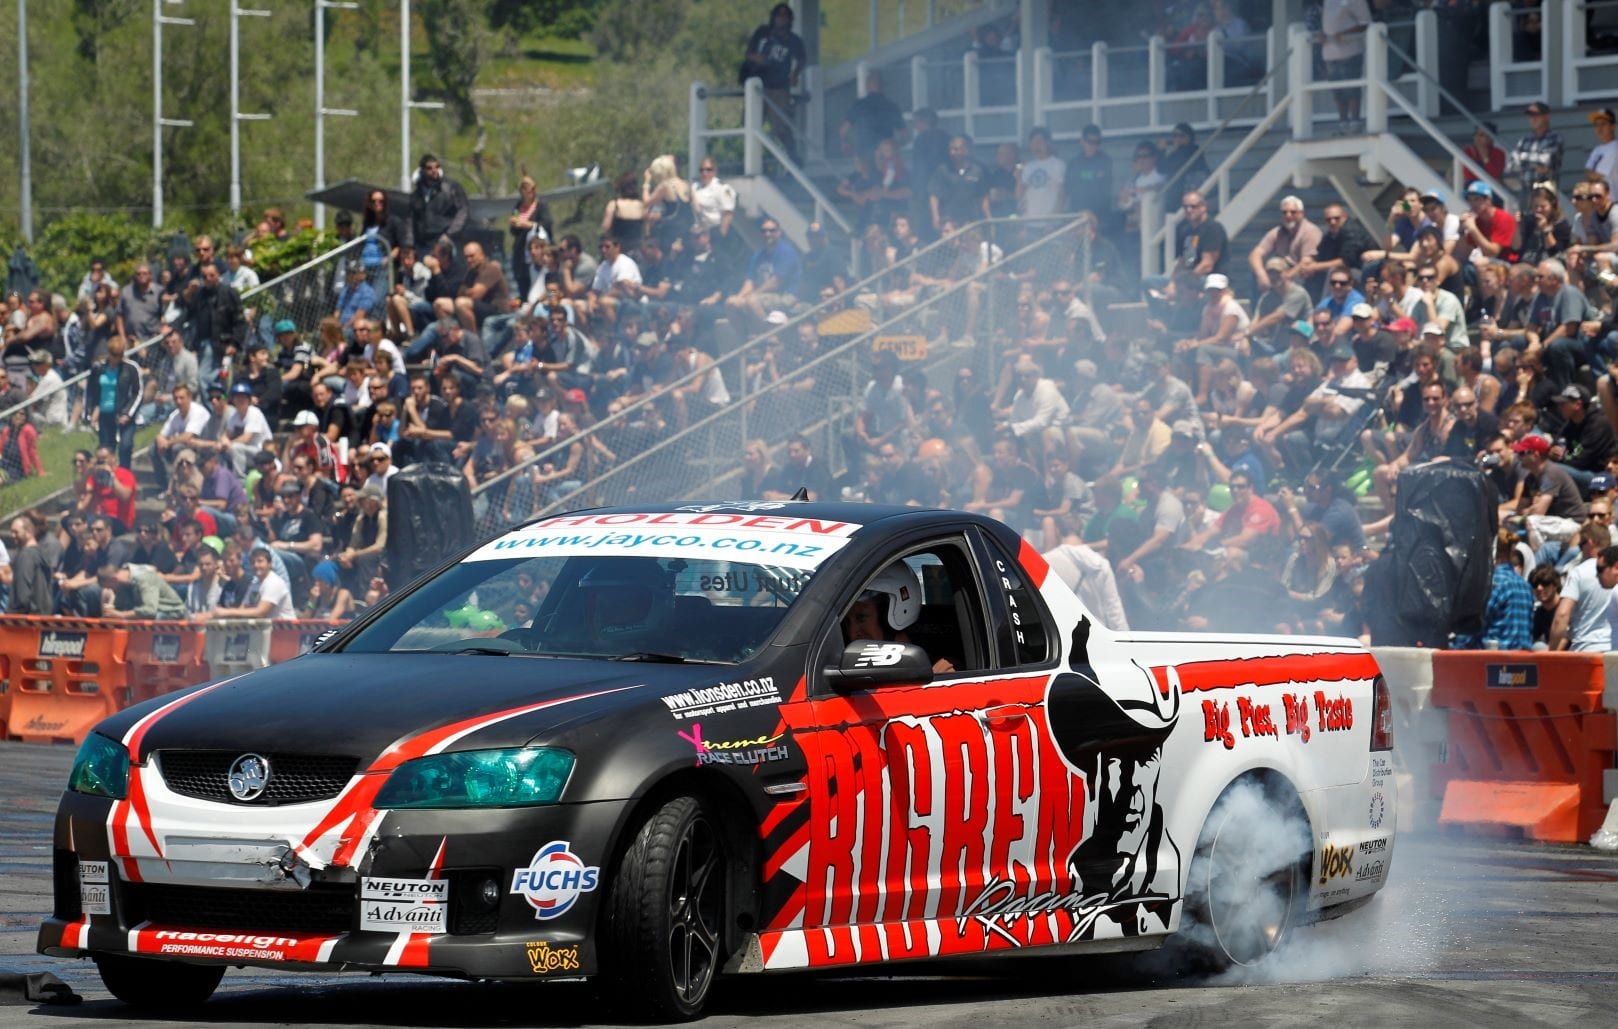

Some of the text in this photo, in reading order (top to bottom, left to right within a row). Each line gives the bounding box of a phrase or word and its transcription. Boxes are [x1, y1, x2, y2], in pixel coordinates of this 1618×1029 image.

[537, 513, 848, 534] HOLDEN
[494, 531, 823, 557] www.jayco.co.nz
[996, 560, 1025, 645] CRASH
[661, 677, 777, 709] www.lionsden.co.nz
[1202, 698, 1235, 749] Big
[1282, 693, 1311, 743] Big
[1314, 690, 1353, 732] Taste
[696, 746, 789, 765] RACE CLUTCH
[1359, 838, 1387, 850] NEUTON
[367, 881, 445, 893] NEUTON
[513, 869, 597, 891] FUCHS
[367, 906, 443, 922] Advanti
[954, 876, 1169, 948] Racing
[161, 944, 225, 956] PERFORMANCE
